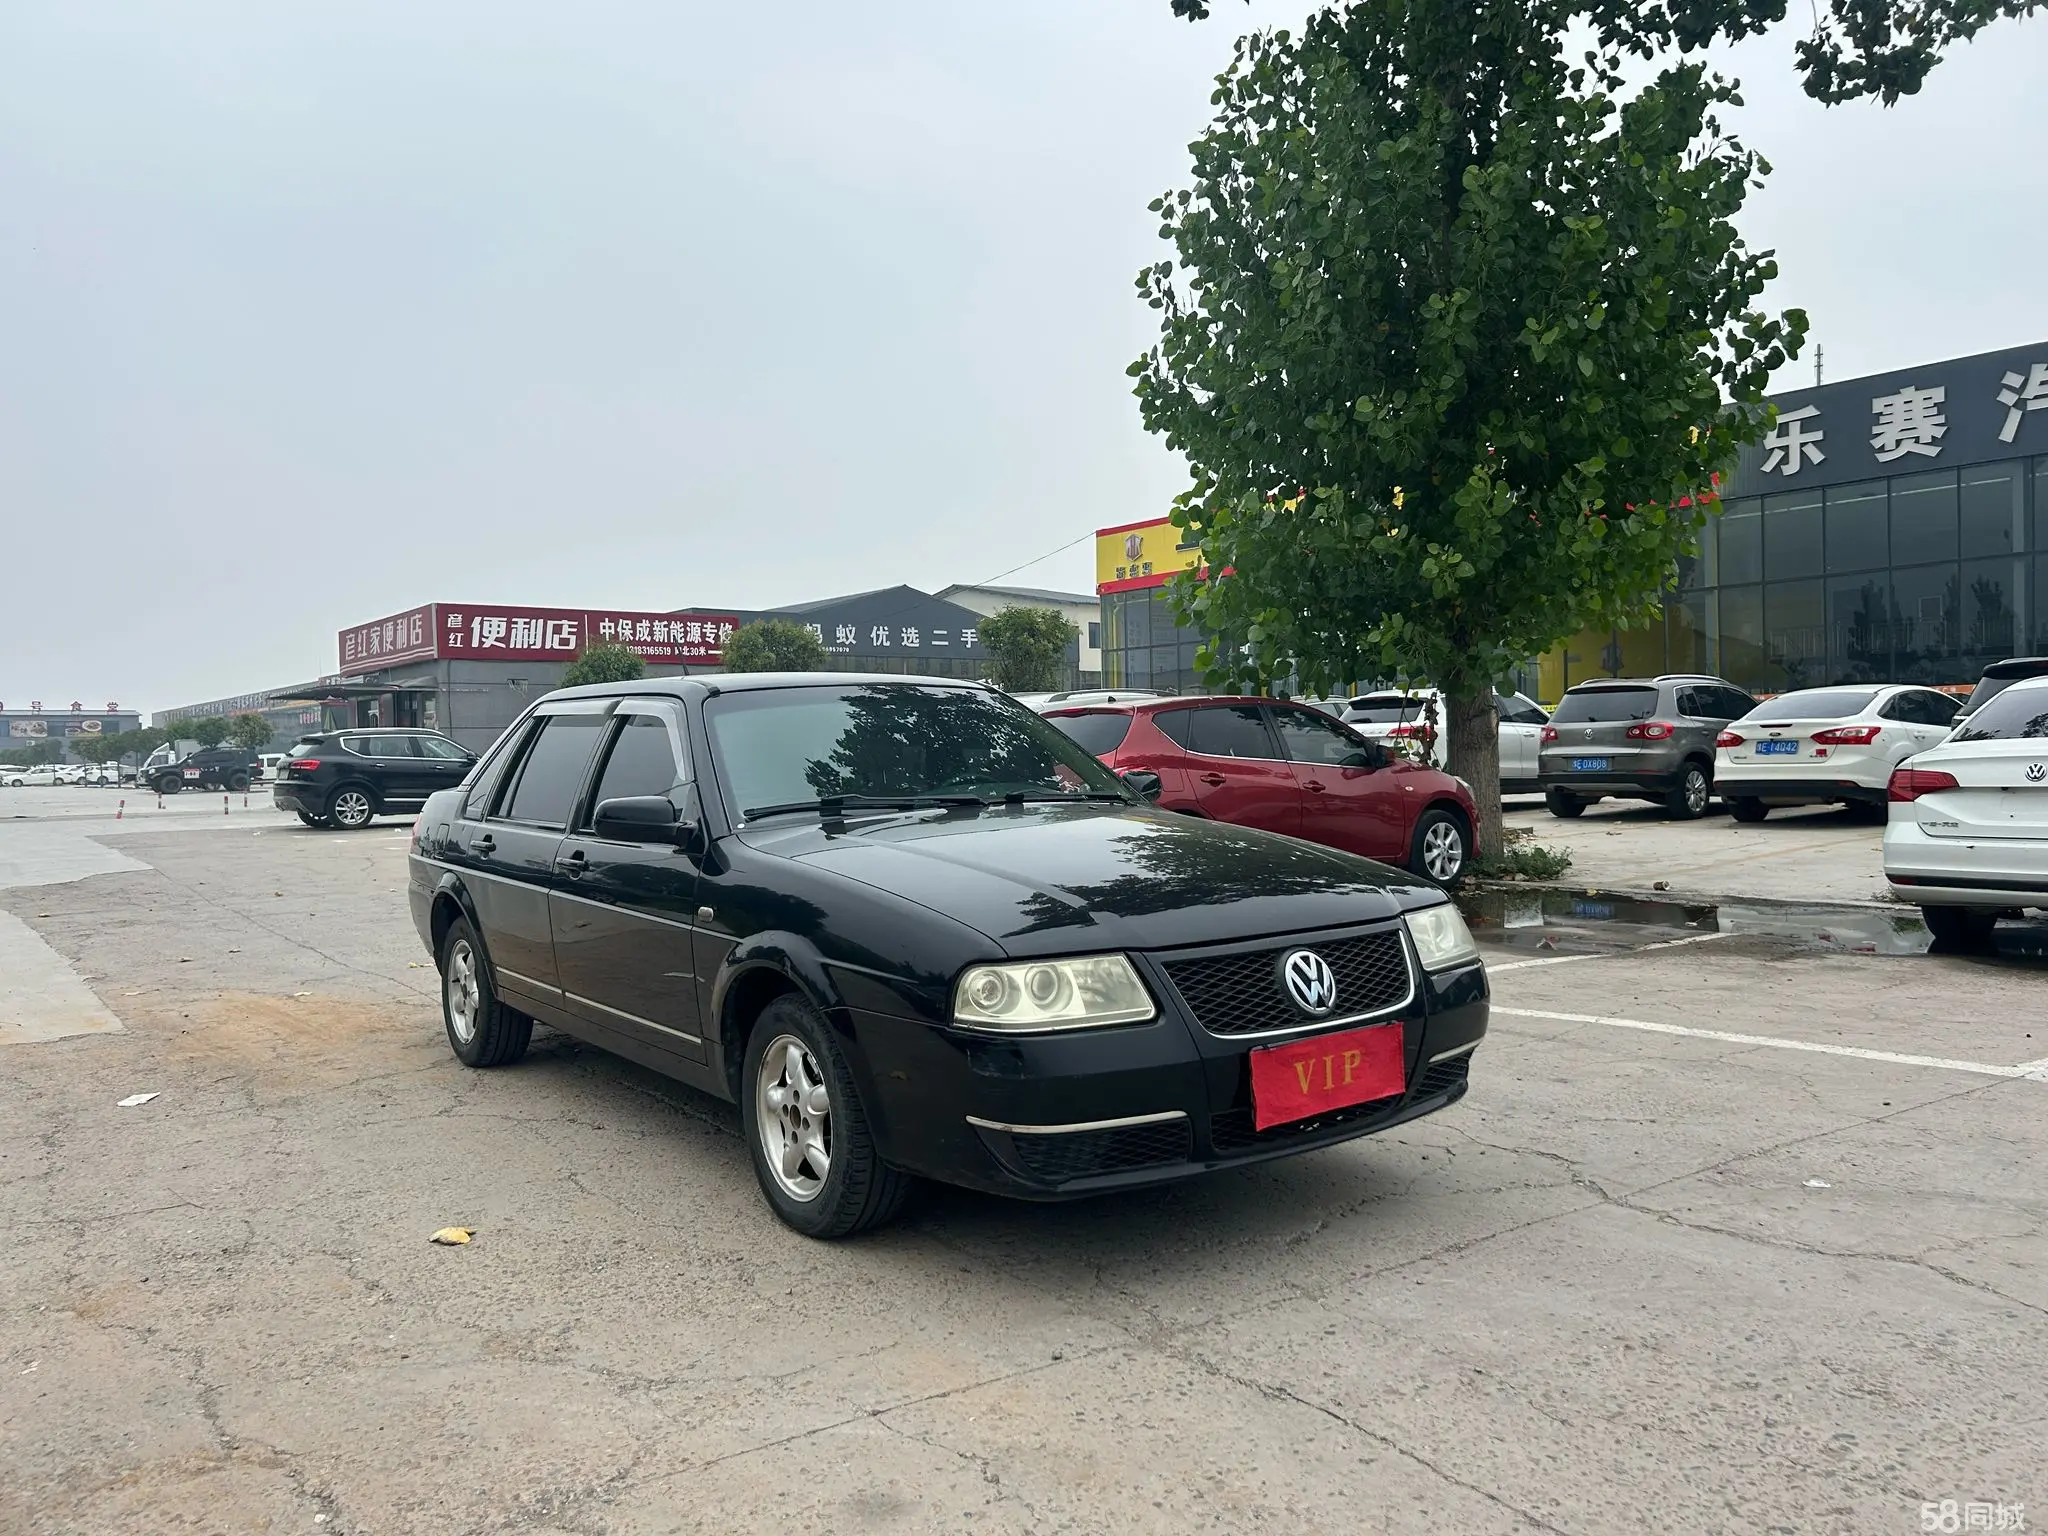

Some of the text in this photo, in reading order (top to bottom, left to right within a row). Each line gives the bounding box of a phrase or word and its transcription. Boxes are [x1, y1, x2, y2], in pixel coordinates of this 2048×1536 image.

[471, 616, 579, 650] 便利店
[1294, 1050, 1361, 1094] VIP
